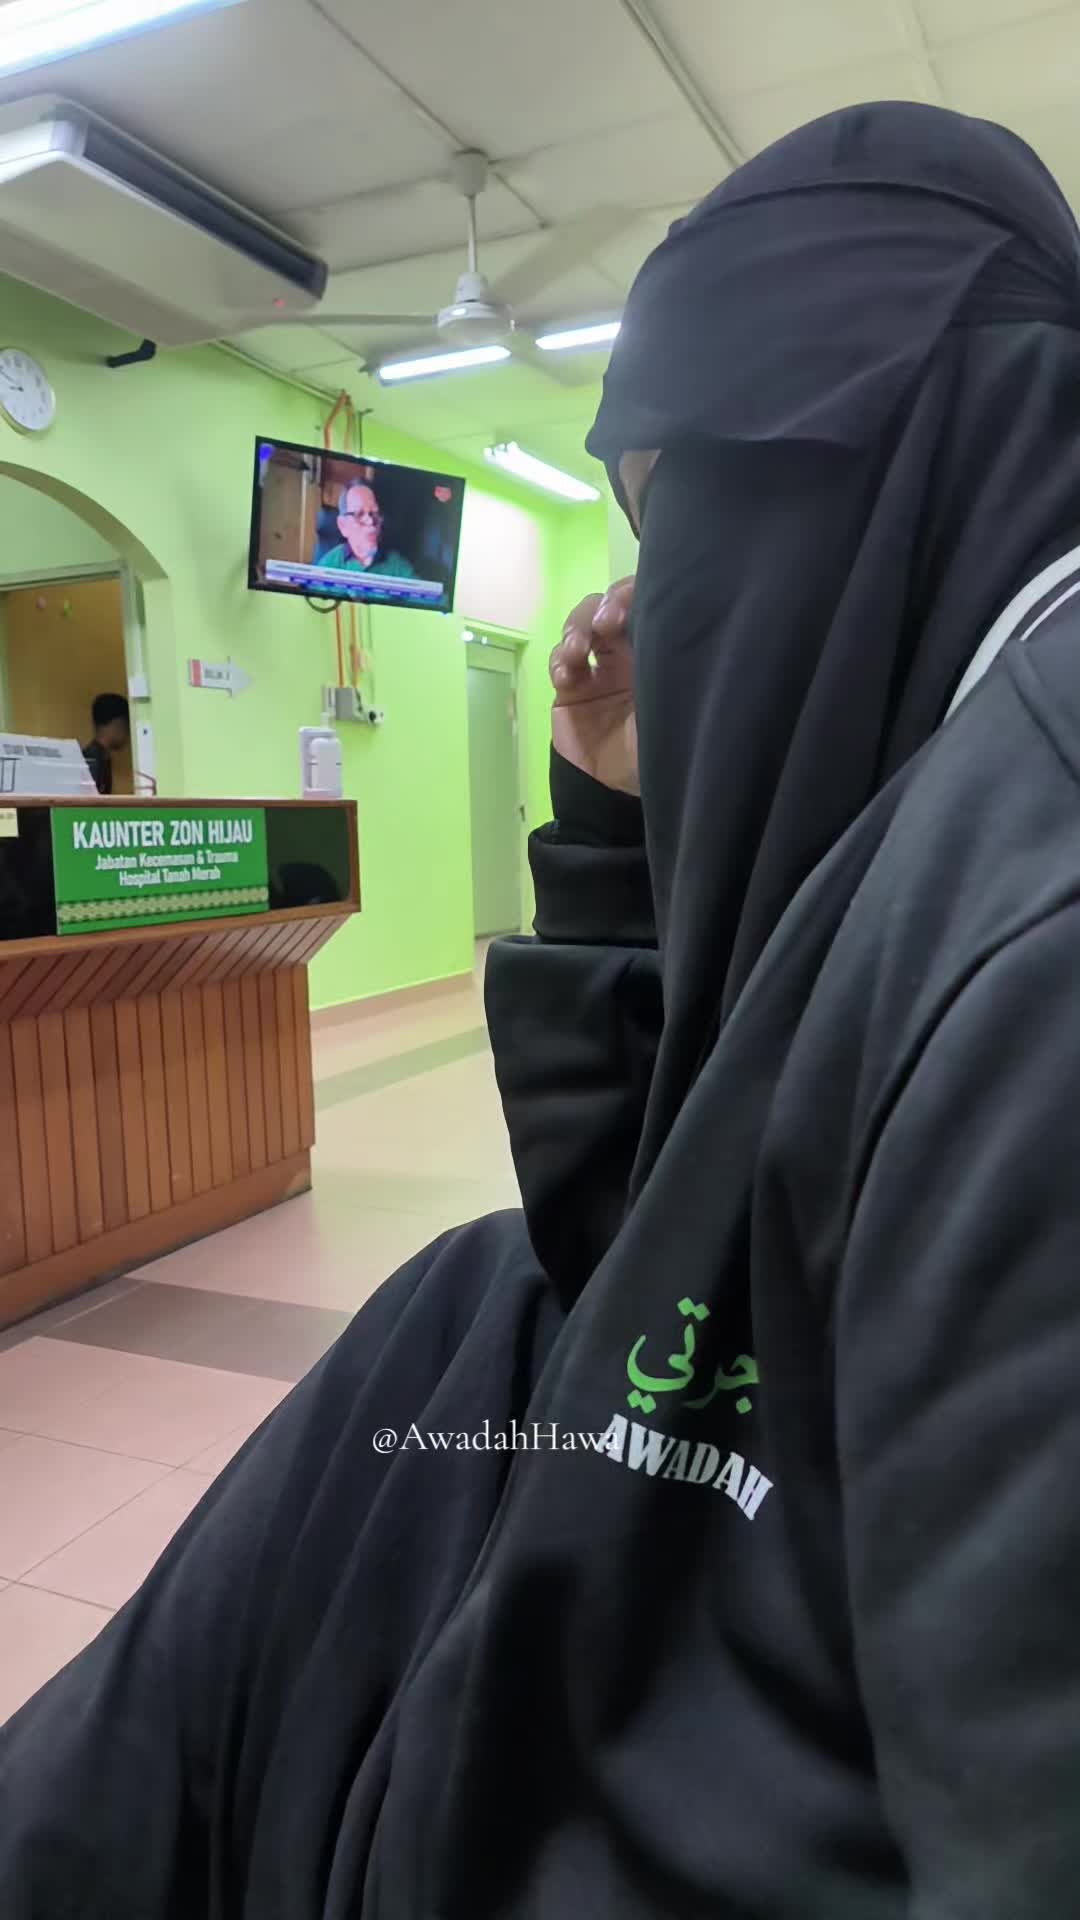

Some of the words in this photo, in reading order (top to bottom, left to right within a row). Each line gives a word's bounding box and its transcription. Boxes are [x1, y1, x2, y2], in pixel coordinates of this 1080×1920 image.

[73, 820, 165, 849] KAUNTER
[169, 819, 204, 847] ZON
[207, 818, 253, 844] HIJAU
[96, 854, 138, 870] Jabatan
[139, 852, 195, 868] Kecemasan
[196, 849, 205, 865] &
[205, 849, 239, 864] Trauma
[119, 867, 161, 888] Hospital
[161, 867, 191, 883] Tanah
[191, 865, 222, 880] Merah
[627, 1297, 760, 1414] جرتي
[596, 1413, 775, 1521] AWADAH
